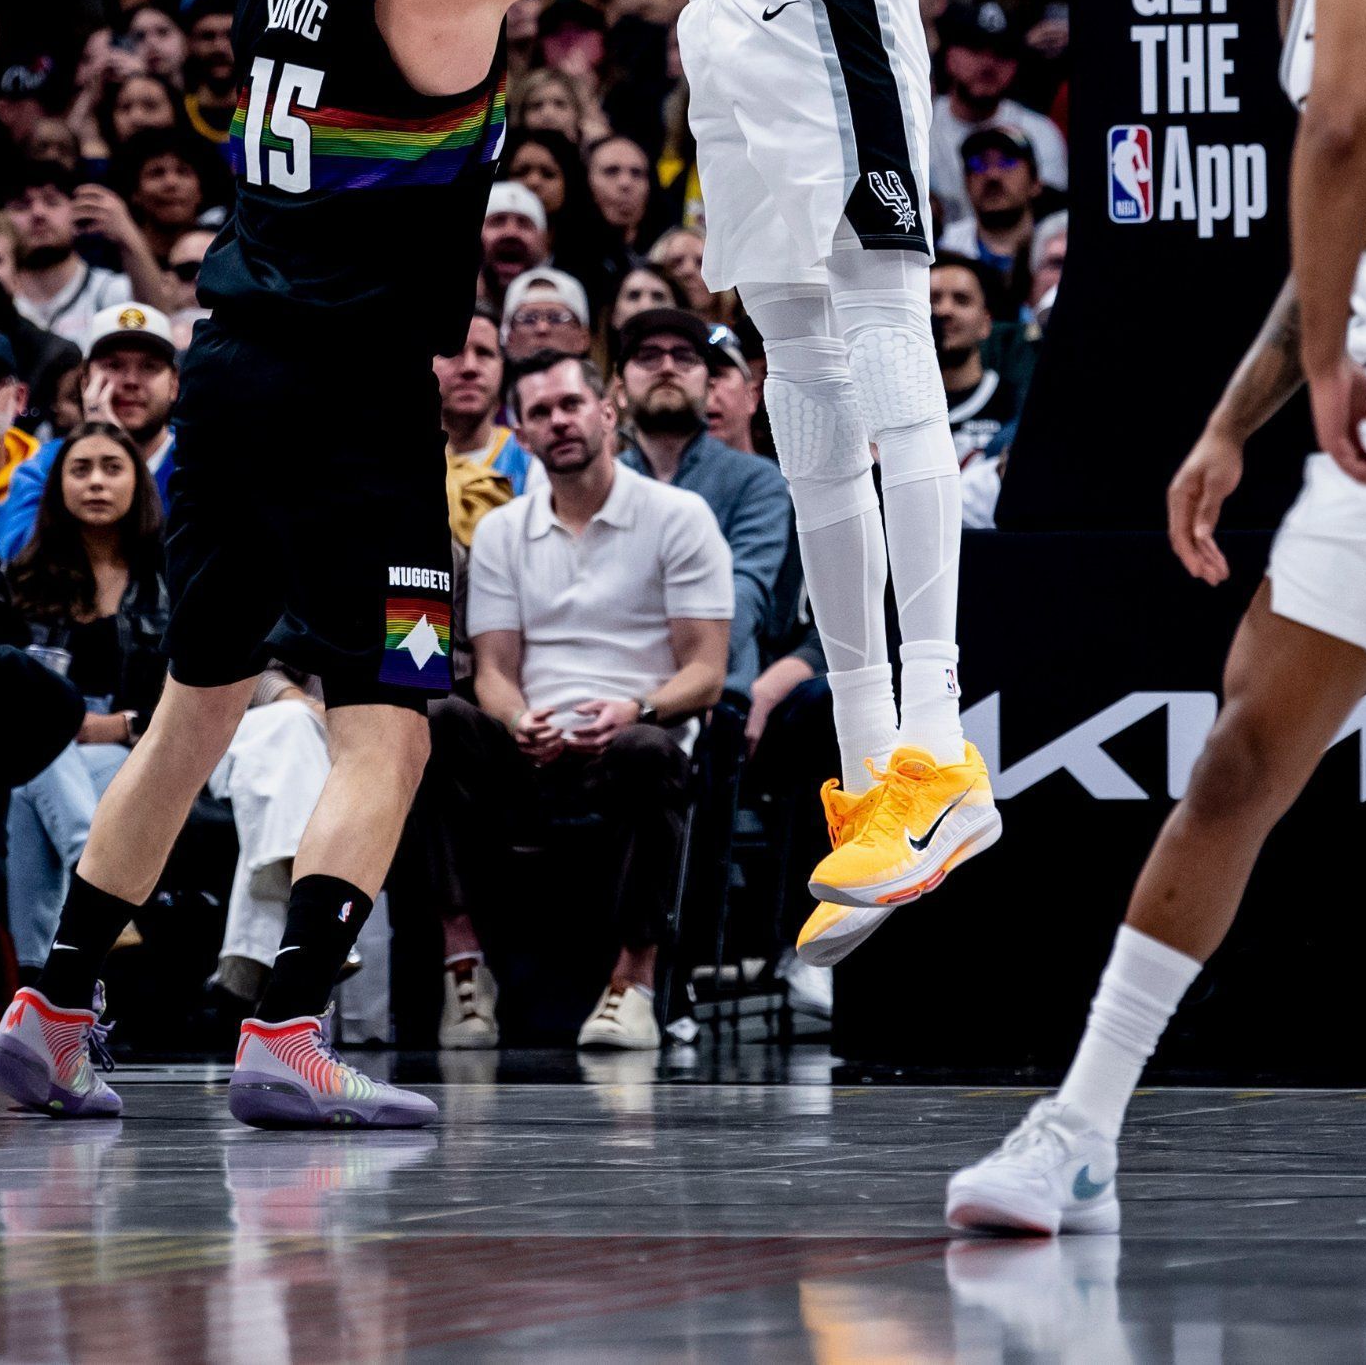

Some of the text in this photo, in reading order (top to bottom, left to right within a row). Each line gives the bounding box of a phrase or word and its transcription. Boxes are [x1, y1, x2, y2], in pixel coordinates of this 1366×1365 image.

[1129, 23, 1240, 114] THE
[244, 56, 326, 194] 15
[1159, 125, 1268, 239] App
[388, 566, 450, 592] NUGGETS
